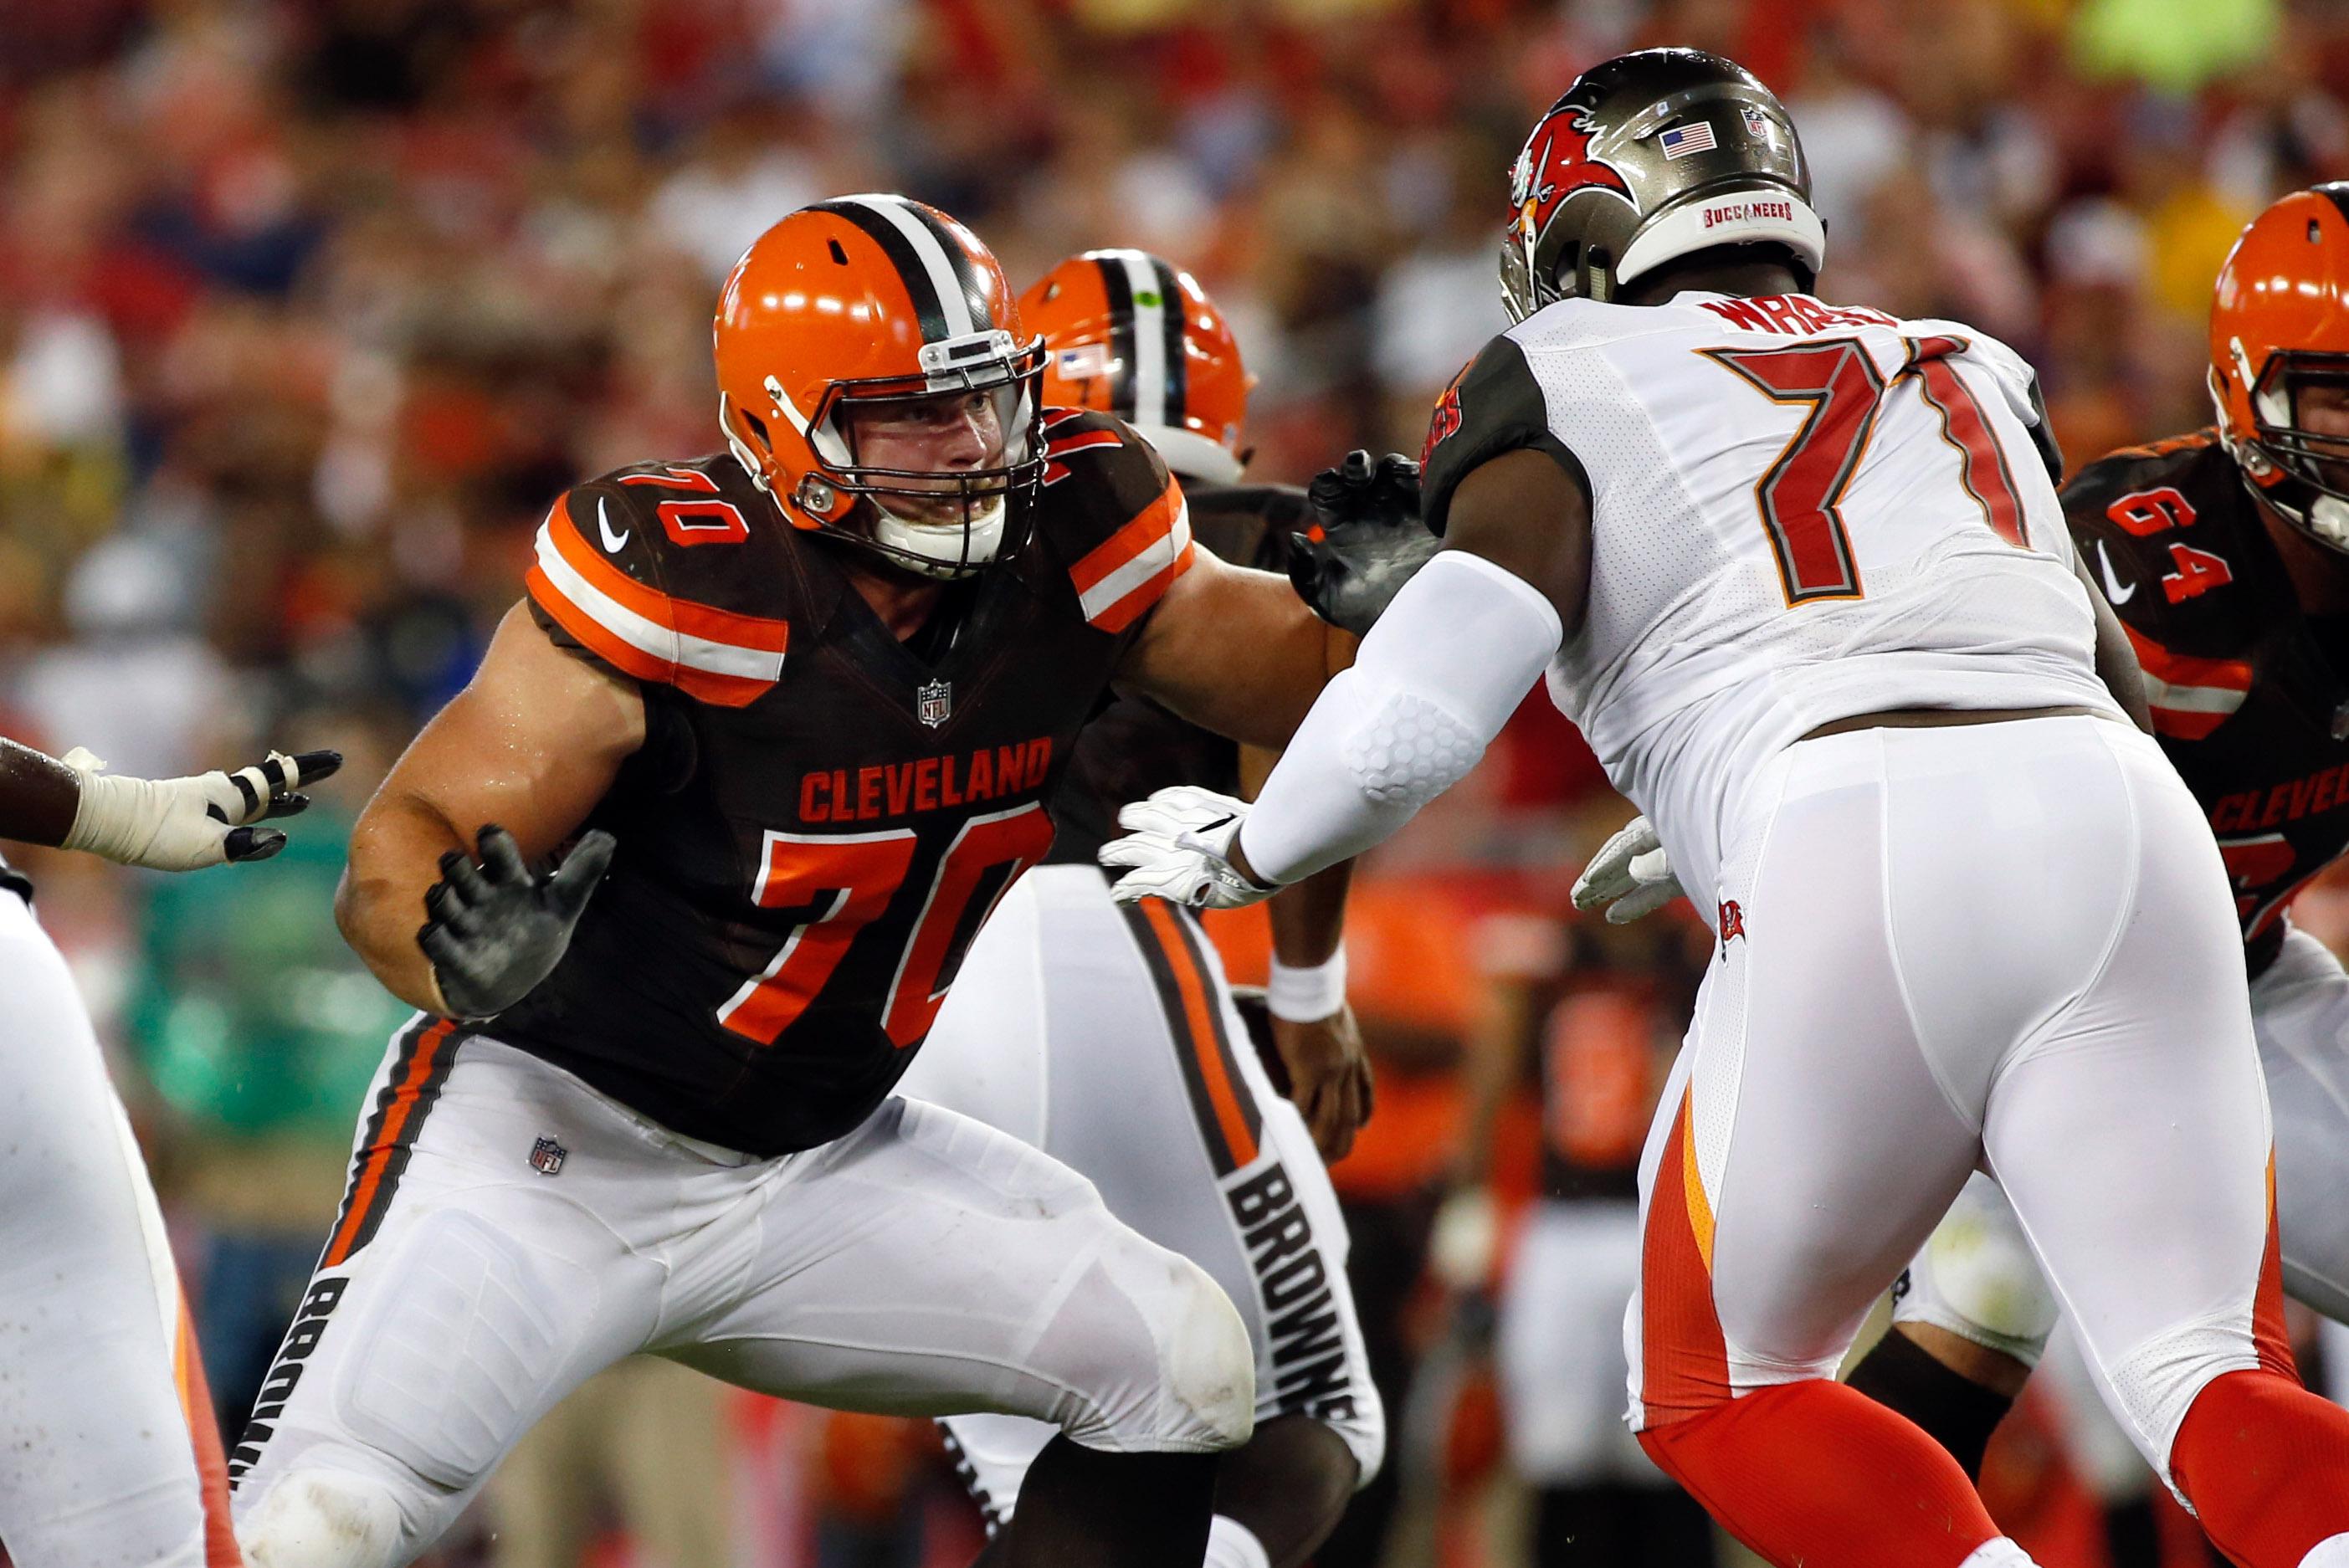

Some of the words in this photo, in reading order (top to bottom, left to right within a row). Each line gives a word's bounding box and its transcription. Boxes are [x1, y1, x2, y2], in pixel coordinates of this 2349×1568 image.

[1704, 202, 1793, 228] BUCCANEERS
[618, 467, 751, 547] 70
[1690, 335, 2035, 610] 71
[2106, 486, 2234, 604] 64
[799, 736, 1053, 822] CLEVELAND
[716, 800, 1057, 1048] 70
